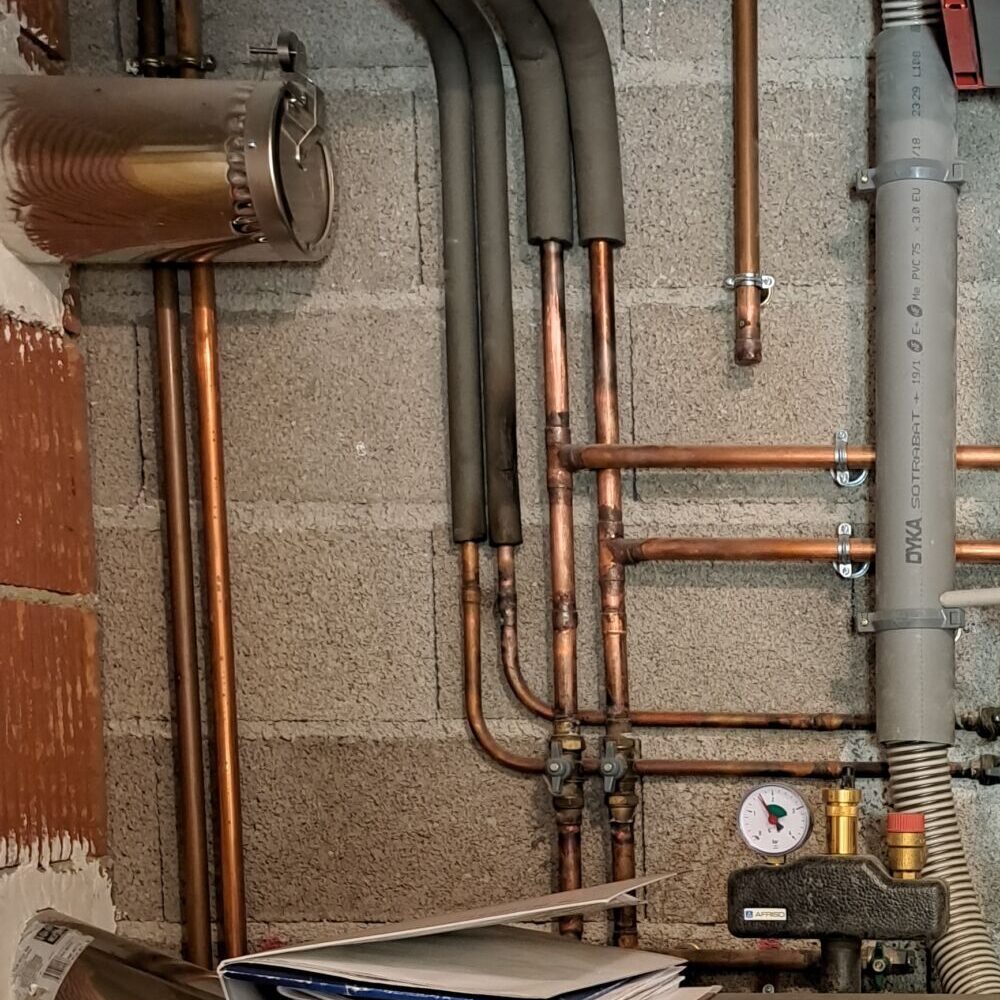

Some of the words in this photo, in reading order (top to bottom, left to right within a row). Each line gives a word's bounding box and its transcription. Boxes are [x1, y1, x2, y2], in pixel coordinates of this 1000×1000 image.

[912, 188, 920, 202] EU
[912, 243, 920, 256] 75
[912, 260, 920, 280] PVC
[911, 410, 921, 508] SOTRABAT
[905, 518, 922, 565] DYKA
